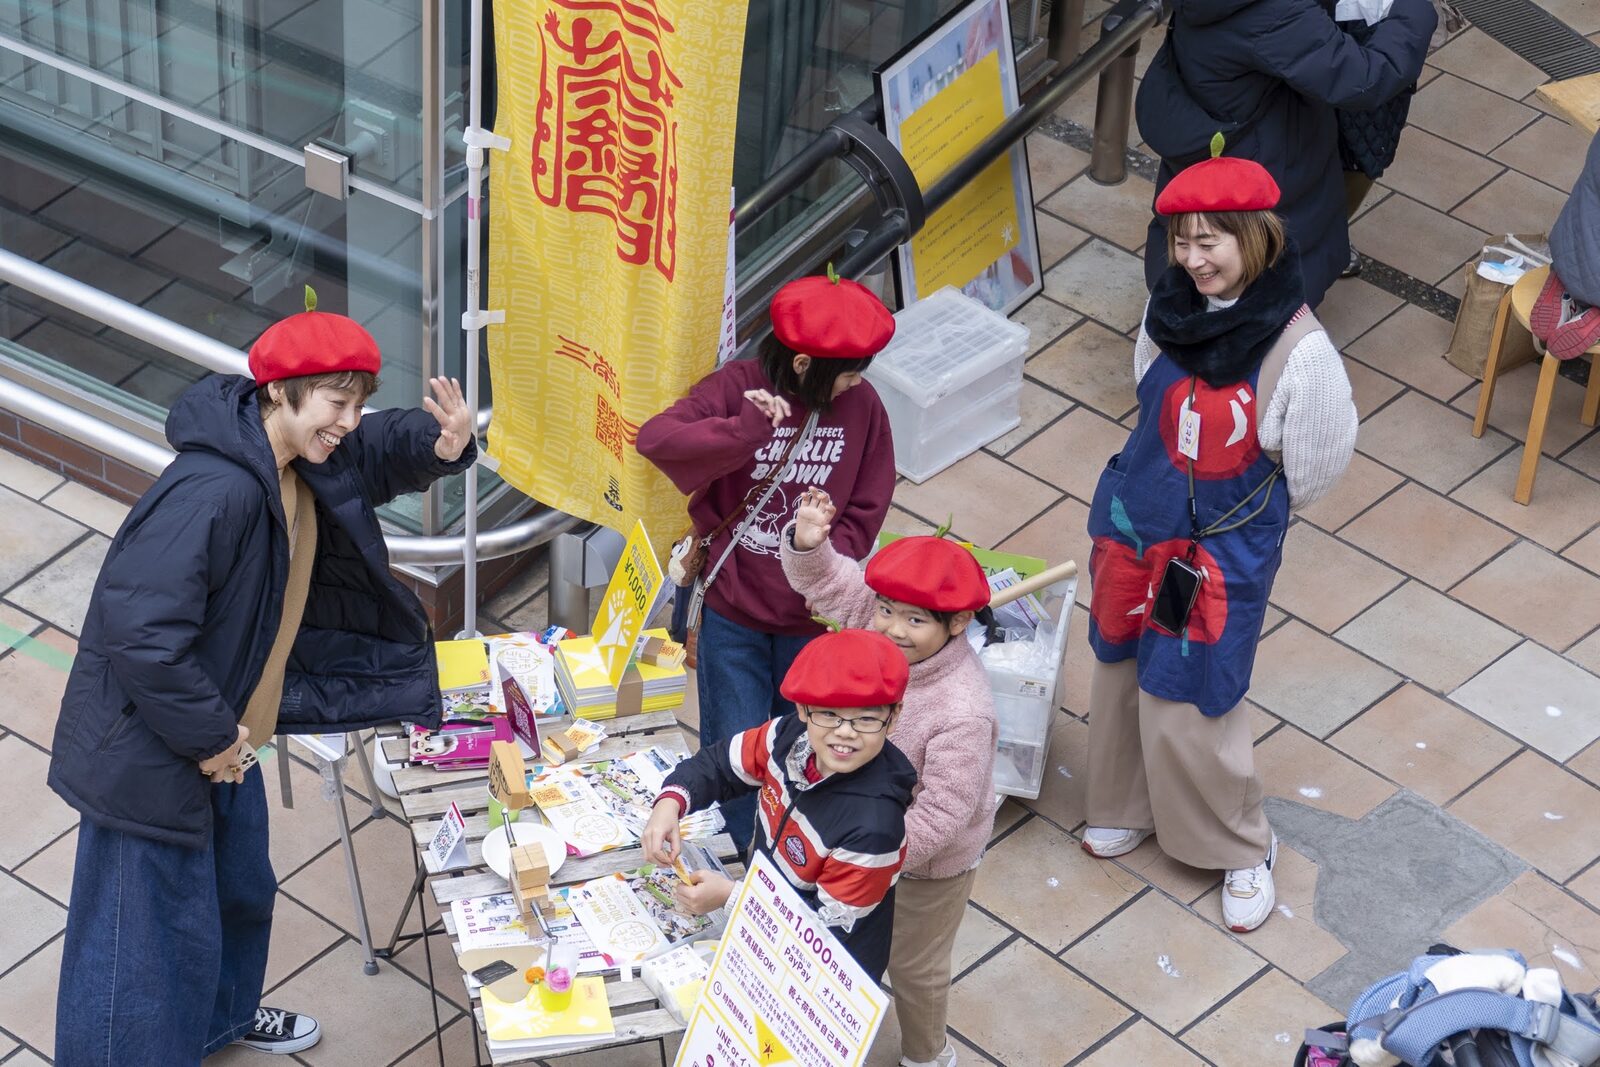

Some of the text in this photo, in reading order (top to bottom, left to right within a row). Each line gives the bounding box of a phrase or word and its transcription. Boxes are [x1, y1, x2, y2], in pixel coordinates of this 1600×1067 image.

[813, 427, 845, 439] ERFECT,
[754, 439, 845, 463] CHRLIE
[625, 557, 647, 610] ¥1,000
[748, 896, 778, 934] 未就学児の
[773, 896, 794, 923] 参加費
[784, 947, 811, 982] PayPay
[722, 992, 754, 1035] 時間制限なし
[716, 1025, 732, 1048] LINE
[731, 1046, 739, 1058] or
